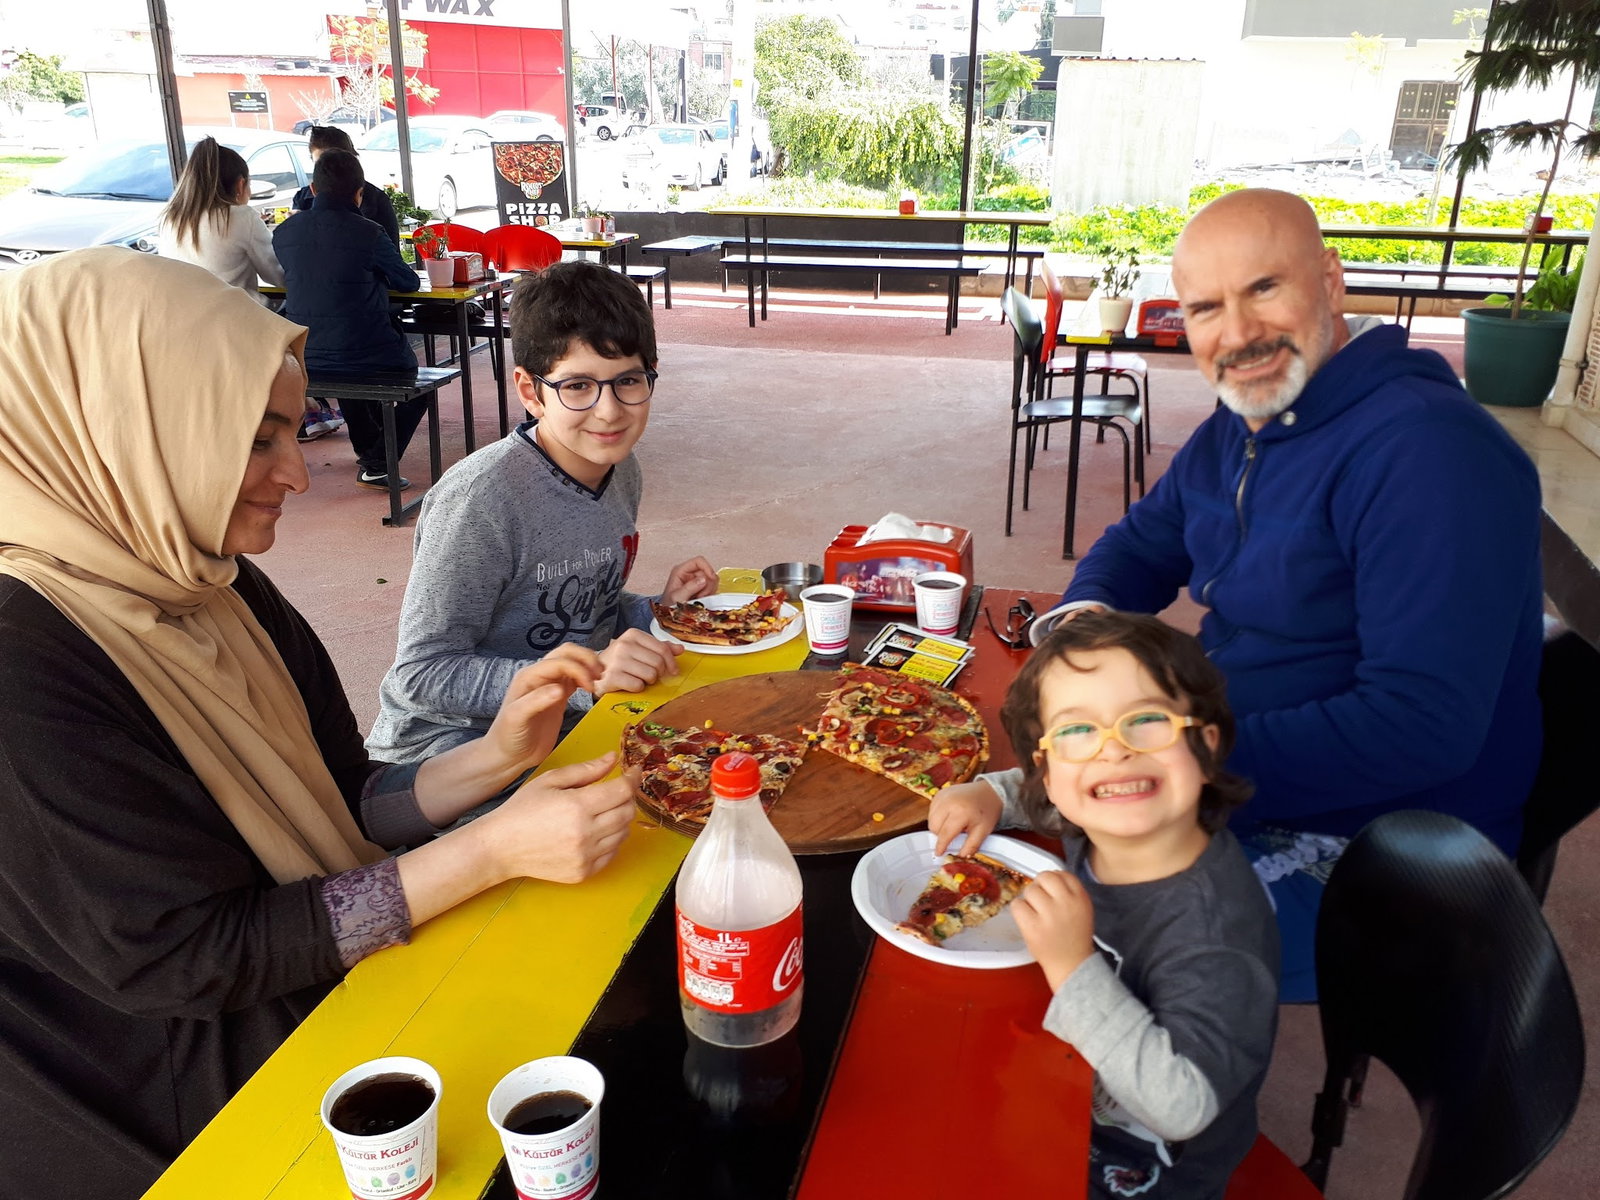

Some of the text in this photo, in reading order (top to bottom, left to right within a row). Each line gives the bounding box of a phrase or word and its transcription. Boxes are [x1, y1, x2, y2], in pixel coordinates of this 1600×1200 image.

[536, 559, 569, 583] BUILT
[717, 932, 733, 944] 1L
[341, 1144, 377, 1160] KÜLTÜR
[380, 1137, 419, 1159] KOLEJİ
[523, 1147, 563, 1160] KÜLTÜR
